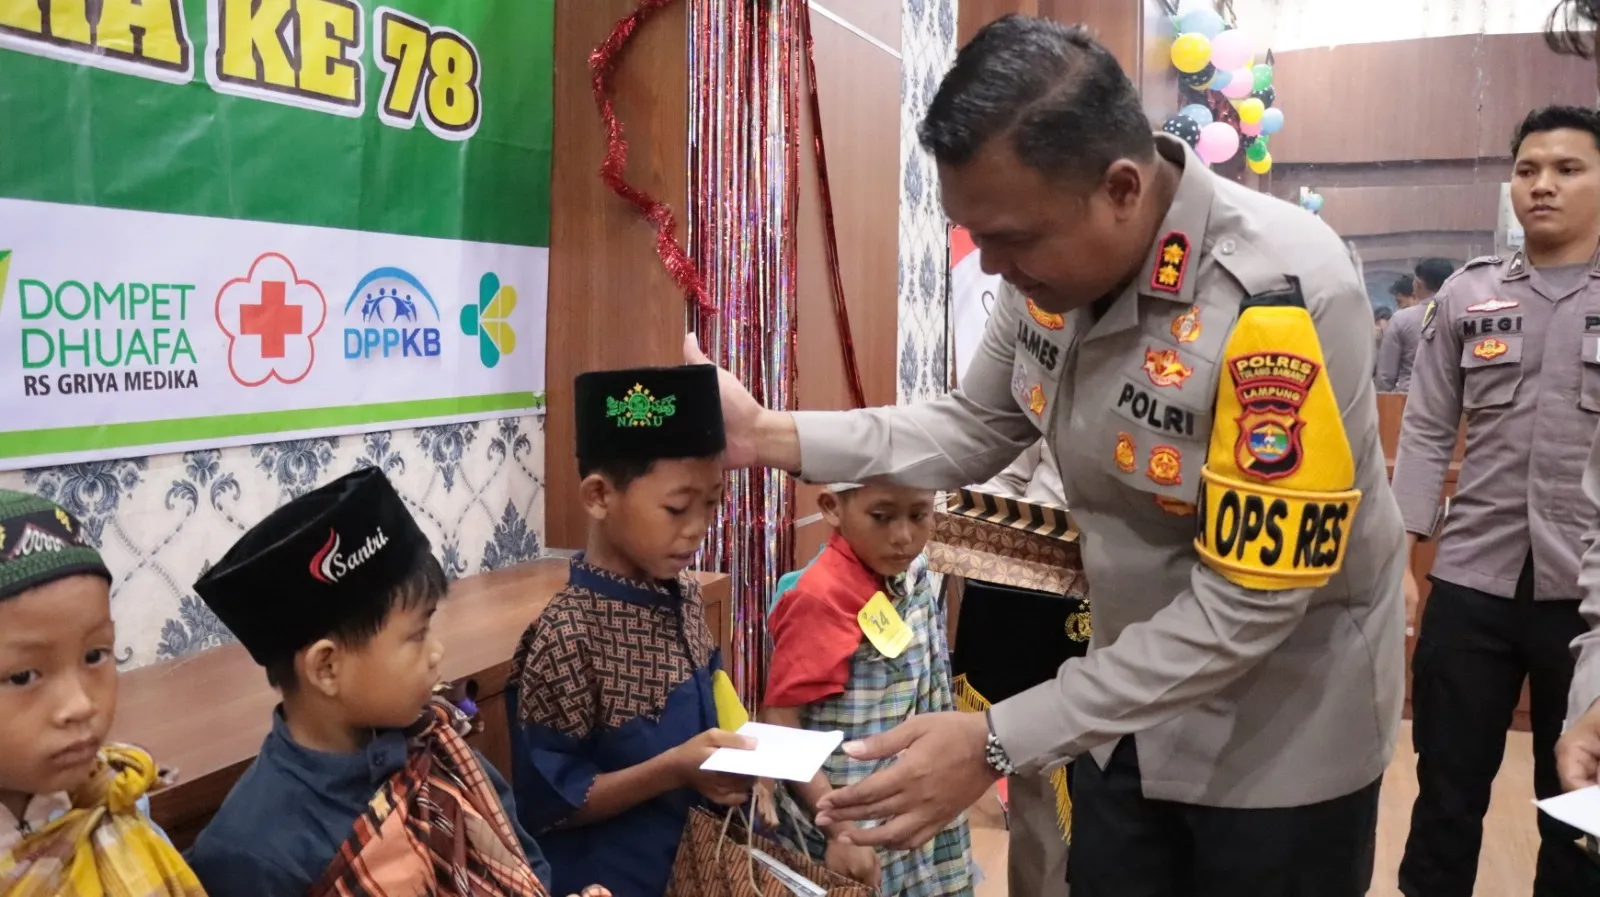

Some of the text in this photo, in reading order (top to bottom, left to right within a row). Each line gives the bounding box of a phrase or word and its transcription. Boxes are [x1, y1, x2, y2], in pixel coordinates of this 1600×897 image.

[212, 0, 363, 112] KE
[377, 9, 480, 135] 78
[19, 279, 196, 320] DOMPET
[344, 327, 441, 359] DPPKB
[1463, 316, 1523, 336] MEGI
[22, 328, 198, 369] DHUAFA
[1017, 319, 1060, 372] JAMES
[24, 369, 199, 396] RS GRIYA MEDIKA
[1236, 355, 1312, 375] POLRES
[1117, 382, 1195, 436] POLRI
[1243, 387, 1301, 402] LAMPUNG
[1215, 489, 1289, 567] OPS
[1293, 502, 1349, 569] RES
[870, 610, 891, 635] 14
